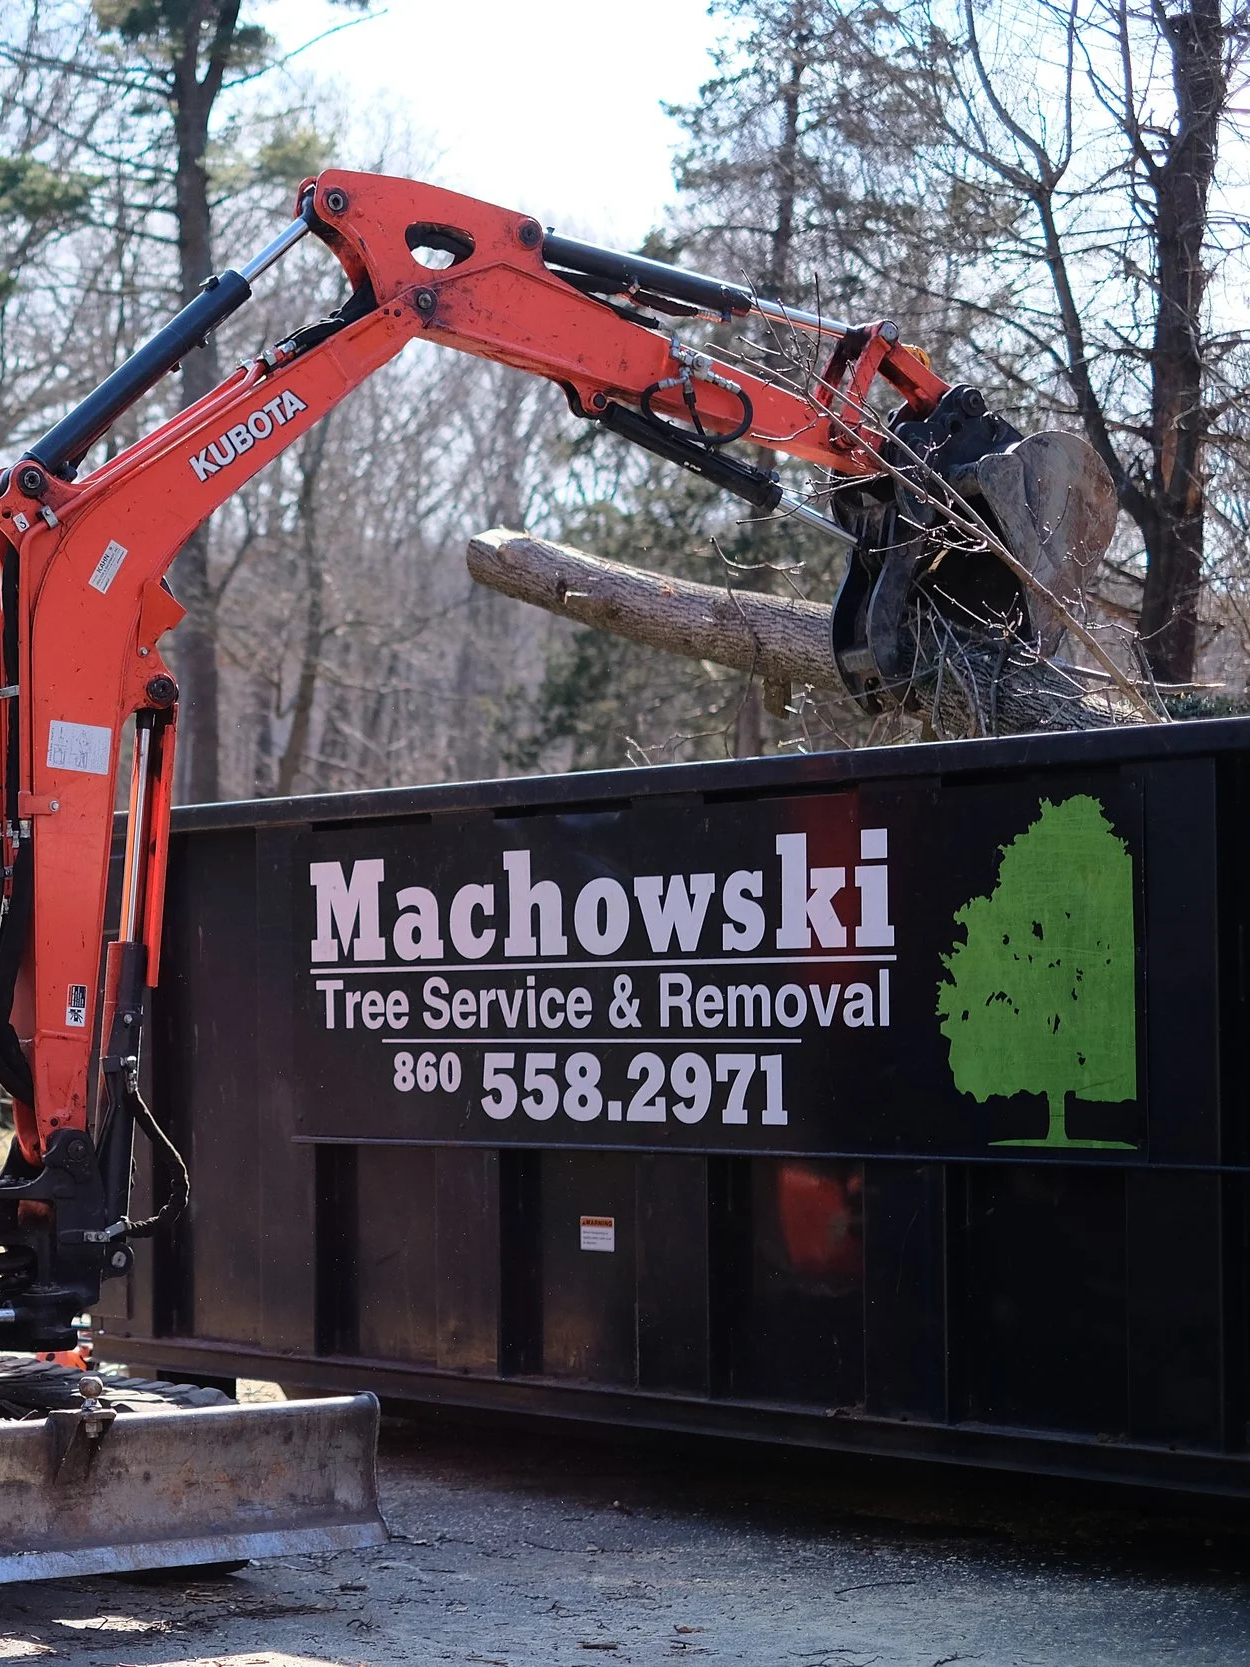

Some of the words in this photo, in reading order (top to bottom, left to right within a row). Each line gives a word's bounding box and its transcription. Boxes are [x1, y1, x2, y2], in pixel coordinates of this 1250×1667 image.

[188, 389, 308, 482] KUBOTA
[97, 554, 110, 573] KAHN
[310, 829, 896, 962] Machowski
[316, 980, 409, 1030] Tree
[423, 975, 592, 1030] Service
[609, 974, 642, 1029] &
[660, 969, 890, 1029] Removal
[393, 1052, 462, 1093] 860
[481, 1052, 788, 1125] 558.2971
